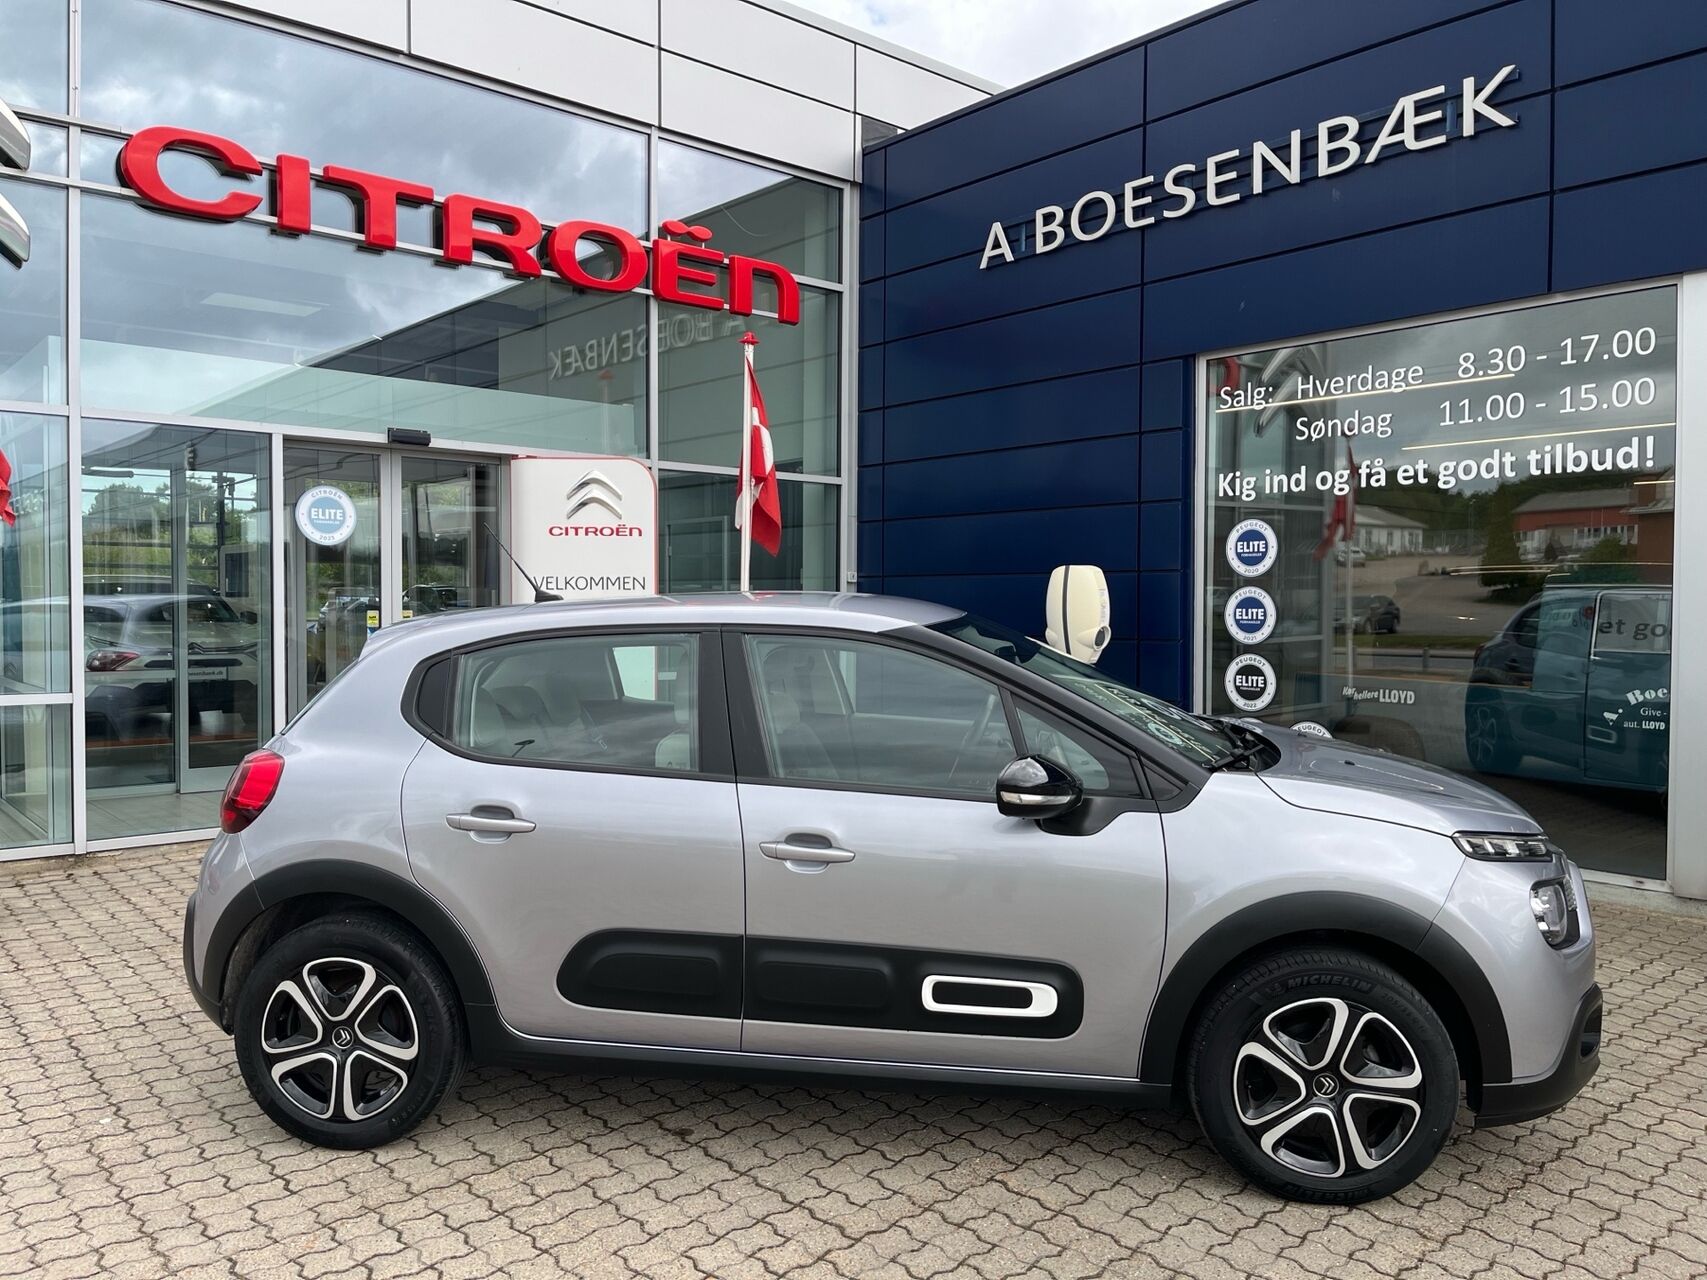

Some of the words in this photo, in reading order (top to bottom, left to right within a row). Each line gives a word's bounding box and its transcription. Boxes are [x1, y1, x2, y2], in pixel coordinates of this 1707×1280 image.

[979, 221, 1015, 271] A
[1035, 64, 1519, 254] BOESENBÆK
[118, 126, 801, 326] CITROËN
[1219, 381, 1274, 411] Salg:
[1297, 364, 1424, 400] Hverdage
[1458, 345, 1527, 379] 8.30
[1560, 327, 1657, 366] 17.00
[1295, 409, 1393, 442] Søndag
[1440, 392, 1525, 427] 11.00
[1559, 376, 1656, 414] 15.00
[1218, 470, 1257, 502] Kig
[1265, 465, 1307, 494] ind
[1315, 469, 1350, 496] og
[1358, 458, 1387, 489] få
[1396, 458, 1429, 486] et
[1437, 448, 1517, 490] godt
[1527, 435, 1655, 477] tilbud!
[311, 507, 344, 520] ELITE
[548, 524, 643, 537] CITROËN
[1235, 522, 1268, 533] PEUGEOT
[1237, 540, 1266, 553] ELITE
[533, 575, 646, 591] VELKOMMEN
[1234, 590, 1267, 600] PEUGEOT
[1235, 608, 1265, 620] ELITE
[1632, 622, 1672, 641] go
[1234, 656, 1267, 667] PEUGEOT
[1235, 675, 1265, 687] ELITE
[1379, 688, 1416, 704] LLOYD
[1640, 707, 1662, 717] Give
[1297, 724, 1326, 737] EUGEOT
[1642, 720, 1666, 730] LLOYD
[1287, 975, 1374, 995] MICHELIN
